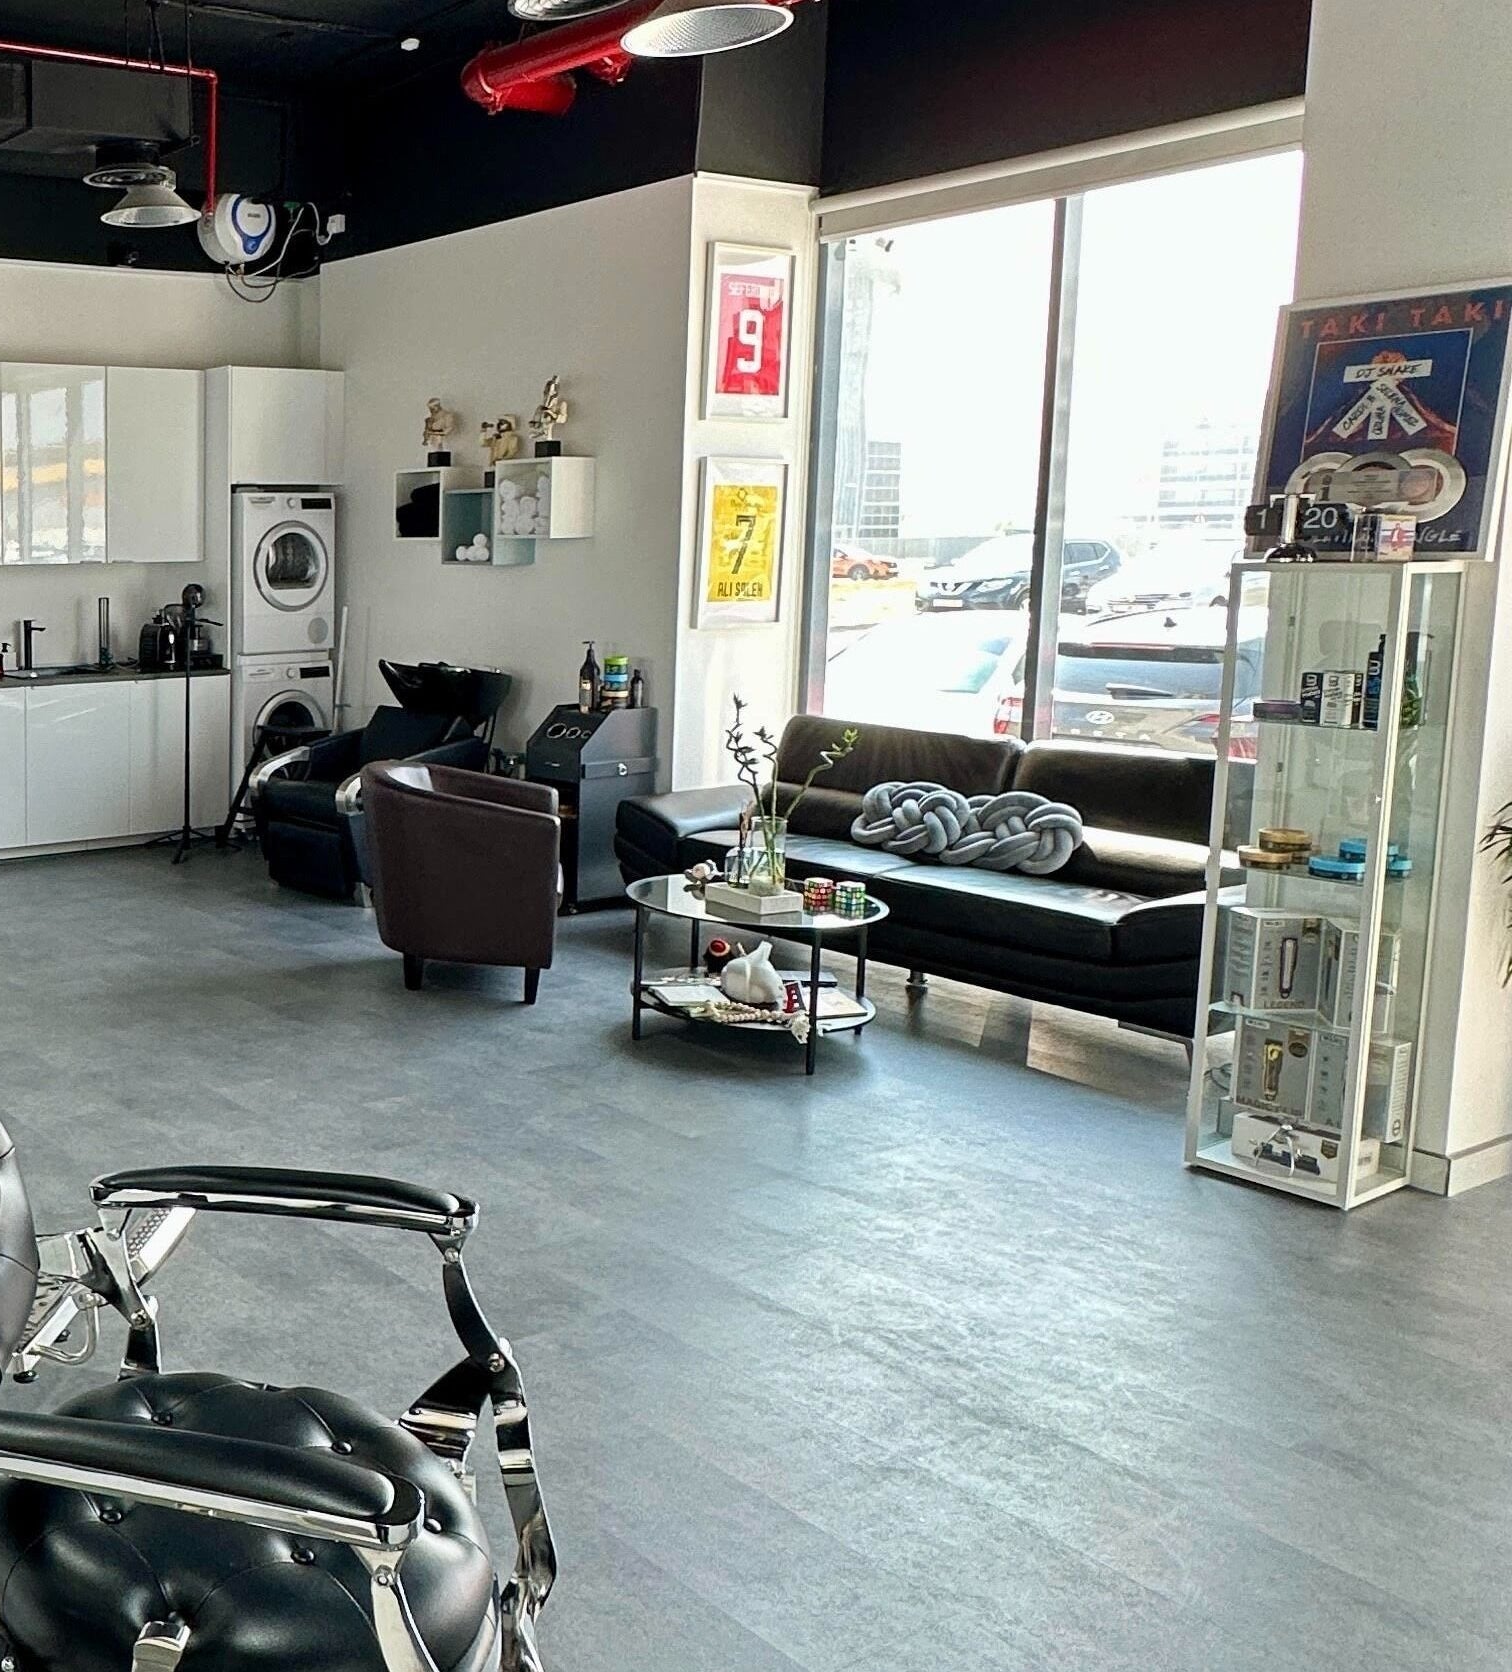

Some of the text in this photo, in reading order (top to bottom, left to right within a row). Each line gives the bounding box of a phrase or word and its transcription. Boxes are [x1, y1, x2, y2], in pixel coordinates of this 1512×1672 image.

[1302, 300, 1506, 339] TAKI TAKI
[737, 308, 764, 374] 9
[1303, 506, 1338, 529] 20
[731, 514, 757, 575] 7
[717, 581, 733, 597] ALI
